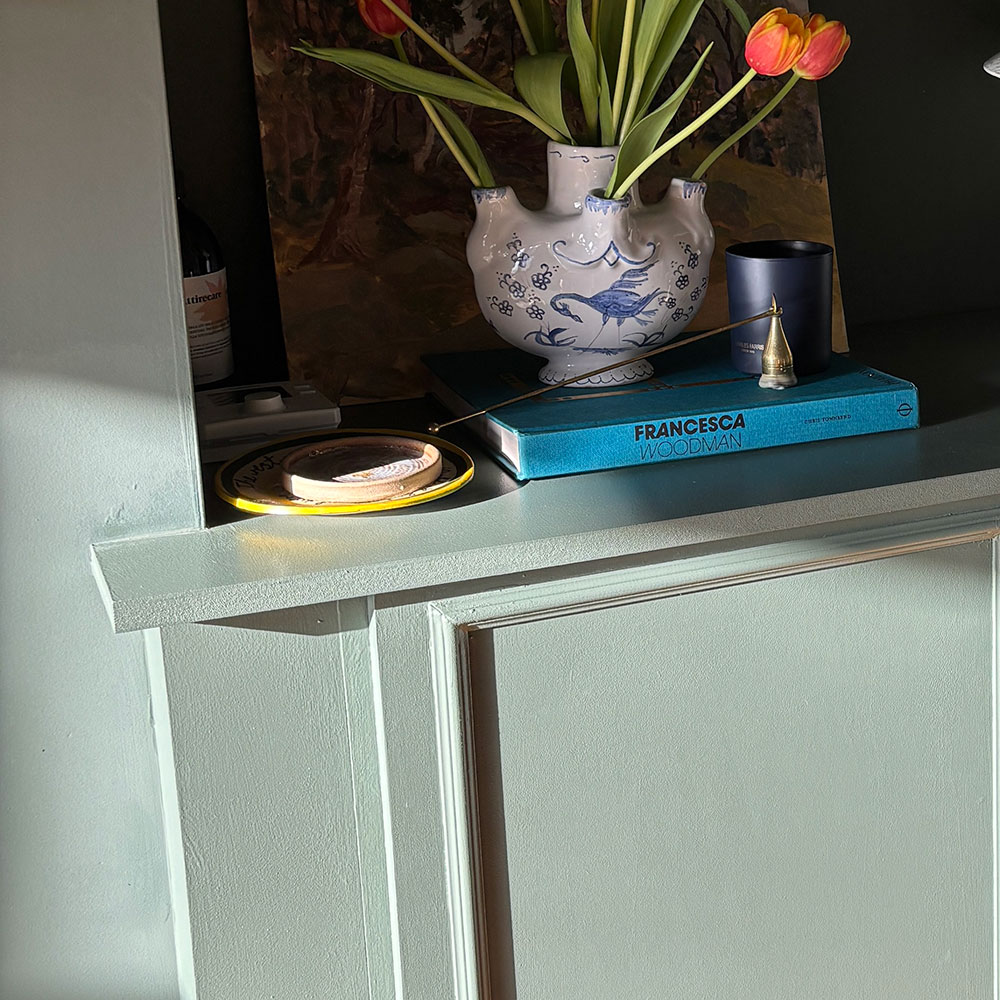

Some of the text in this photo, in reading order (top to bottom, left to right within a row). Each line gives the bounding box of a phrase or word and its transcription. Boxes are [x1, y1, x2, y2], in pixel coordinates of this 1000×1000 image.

[185, 291, 222, 305] ttirecare
[634, 413, 746, 441] FRANCESCA
[639, 432, 742, 460] WOODMAN
